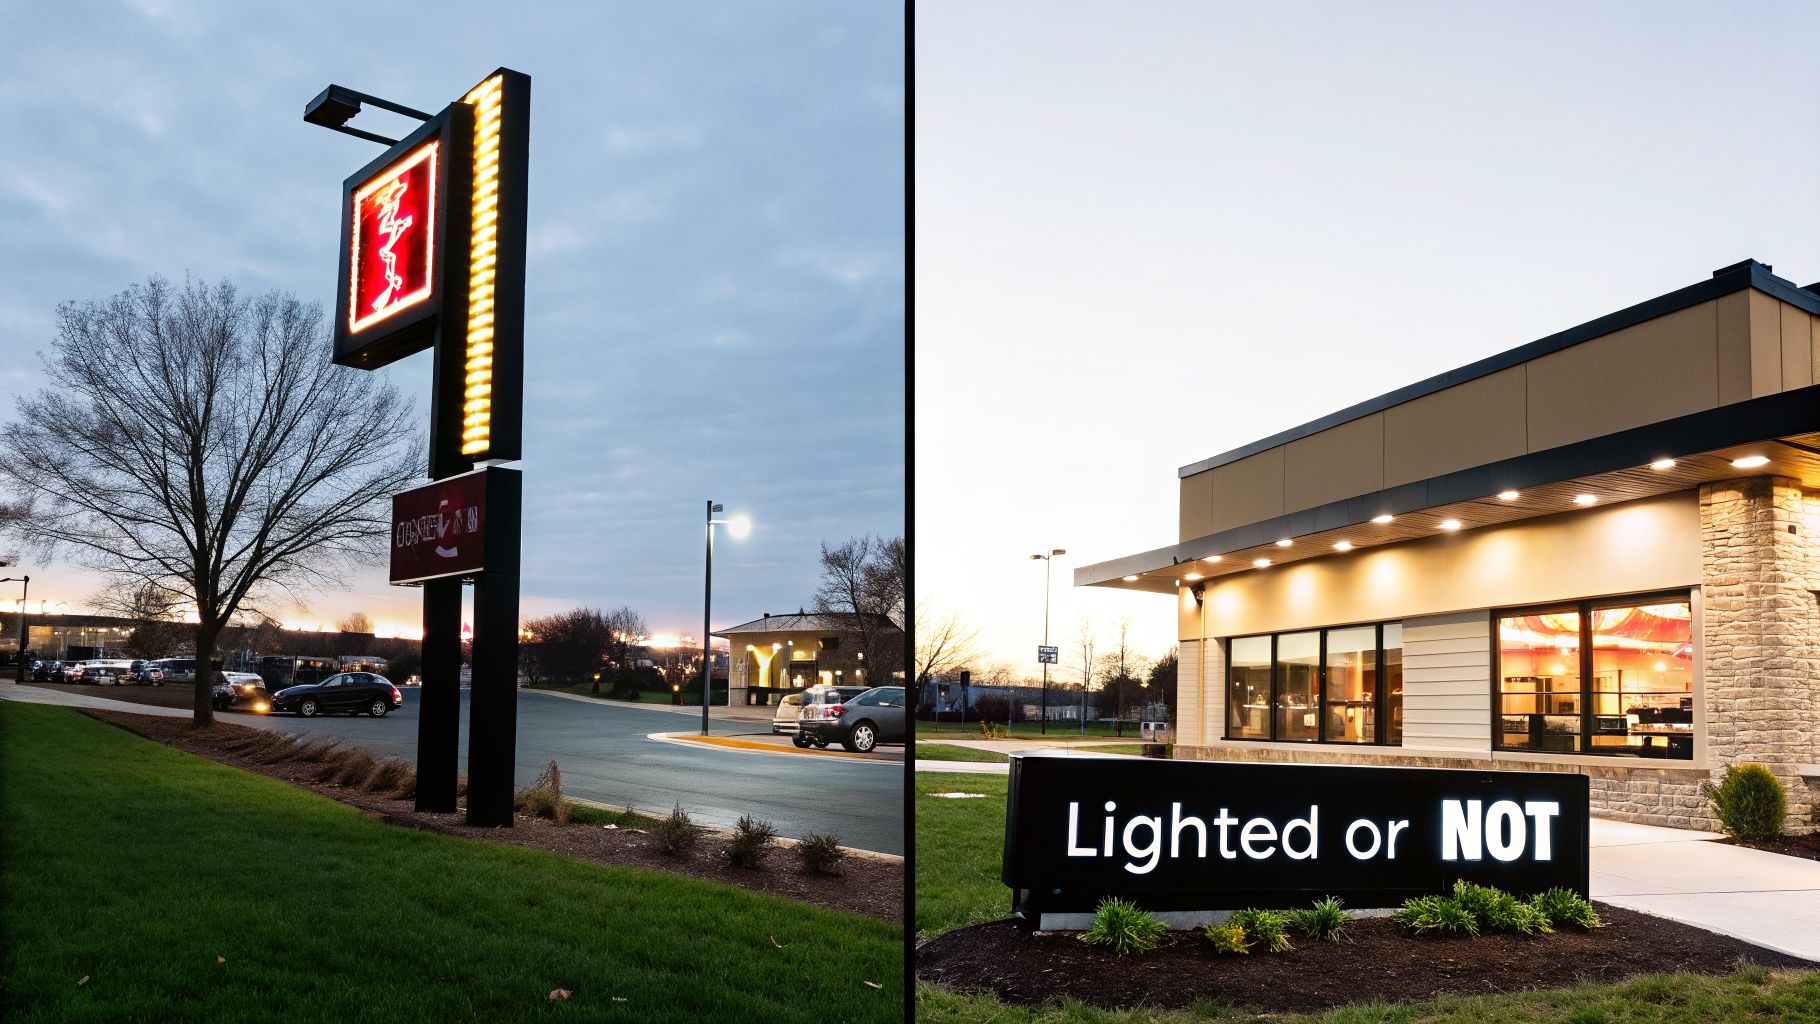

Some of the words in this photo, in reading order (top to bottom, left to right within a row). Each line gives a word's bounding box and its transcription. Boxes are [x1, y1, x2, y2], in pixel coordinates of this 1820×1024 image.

[1067, 800, 1318, 875] Lighted
[1345, 818, 1409, 860] or
[1442, 799, 1560, 862] NOT
